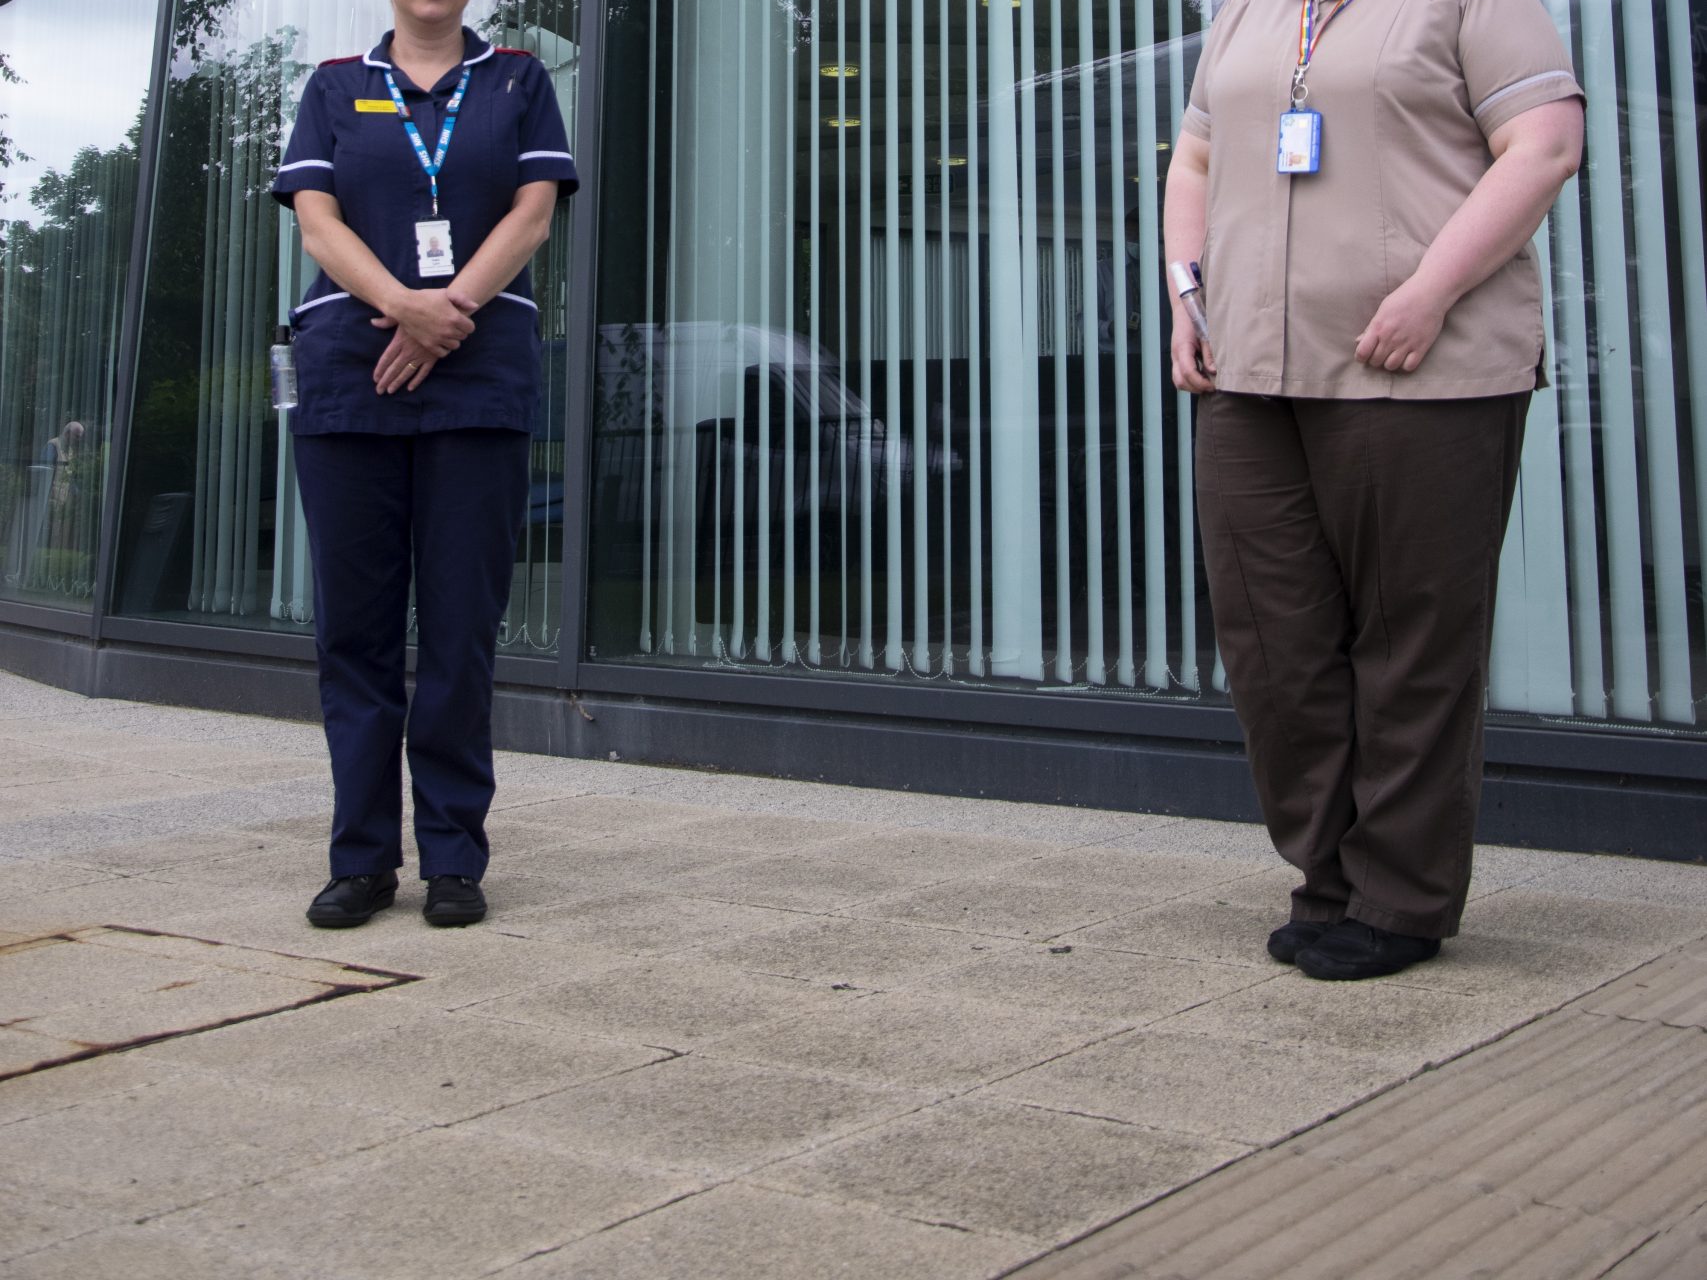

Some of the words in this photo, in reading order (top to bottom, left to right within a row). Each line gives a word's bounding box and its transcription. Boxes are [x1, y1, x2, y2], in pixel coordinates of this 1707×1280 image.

[410, 132, 423, 147] NHS
[440, 129, 451, 145] NHS
[418, 150, 432, 168] NHS
[433, 148, 445, 167] NHS
